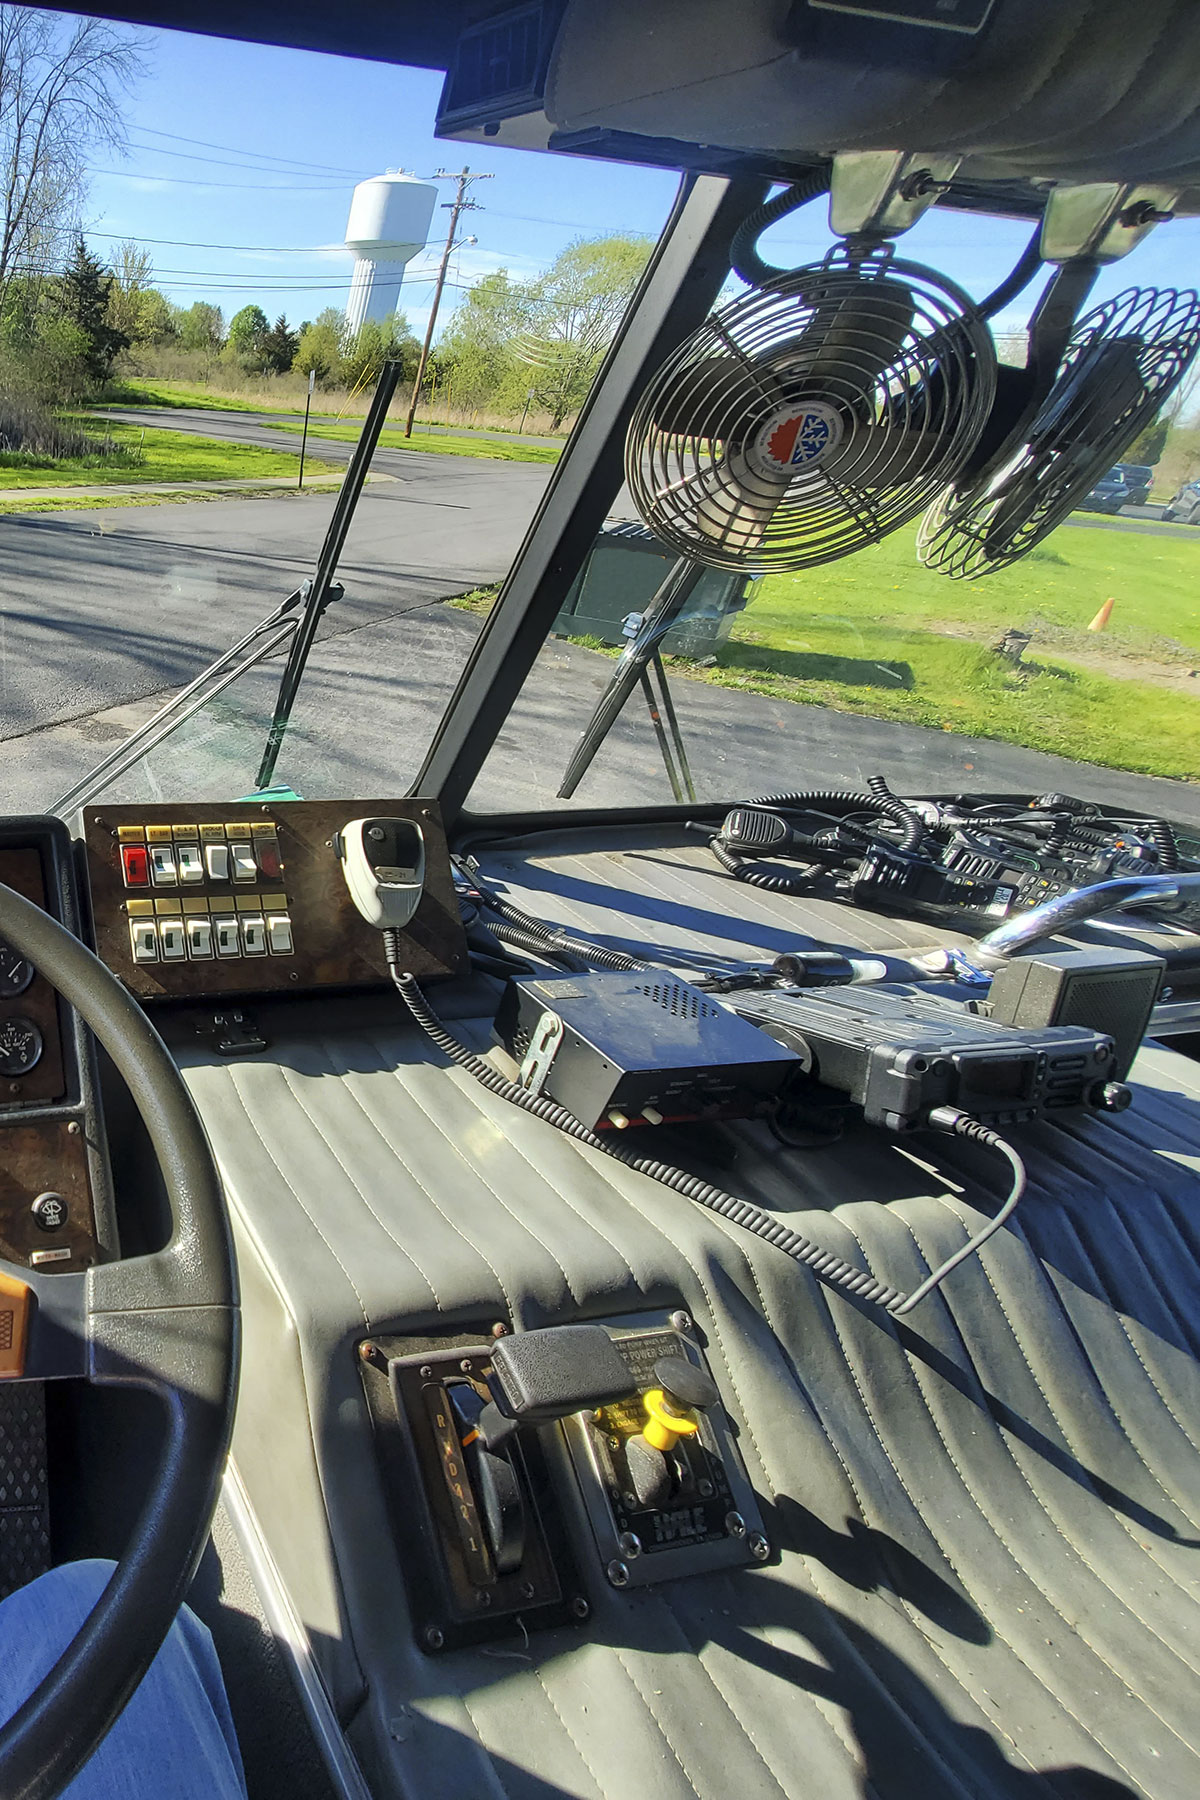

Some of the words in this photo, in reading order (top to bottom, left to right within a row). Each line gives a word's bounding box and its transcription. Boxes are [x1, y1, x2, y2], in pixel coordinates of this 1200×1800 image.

[658, 1344, 679, 1356] SHIFT
[436, 1414, 445, 1428] R
[449, 1462, 458, 1476] D
[469, 1537, 477, 1551] 1
